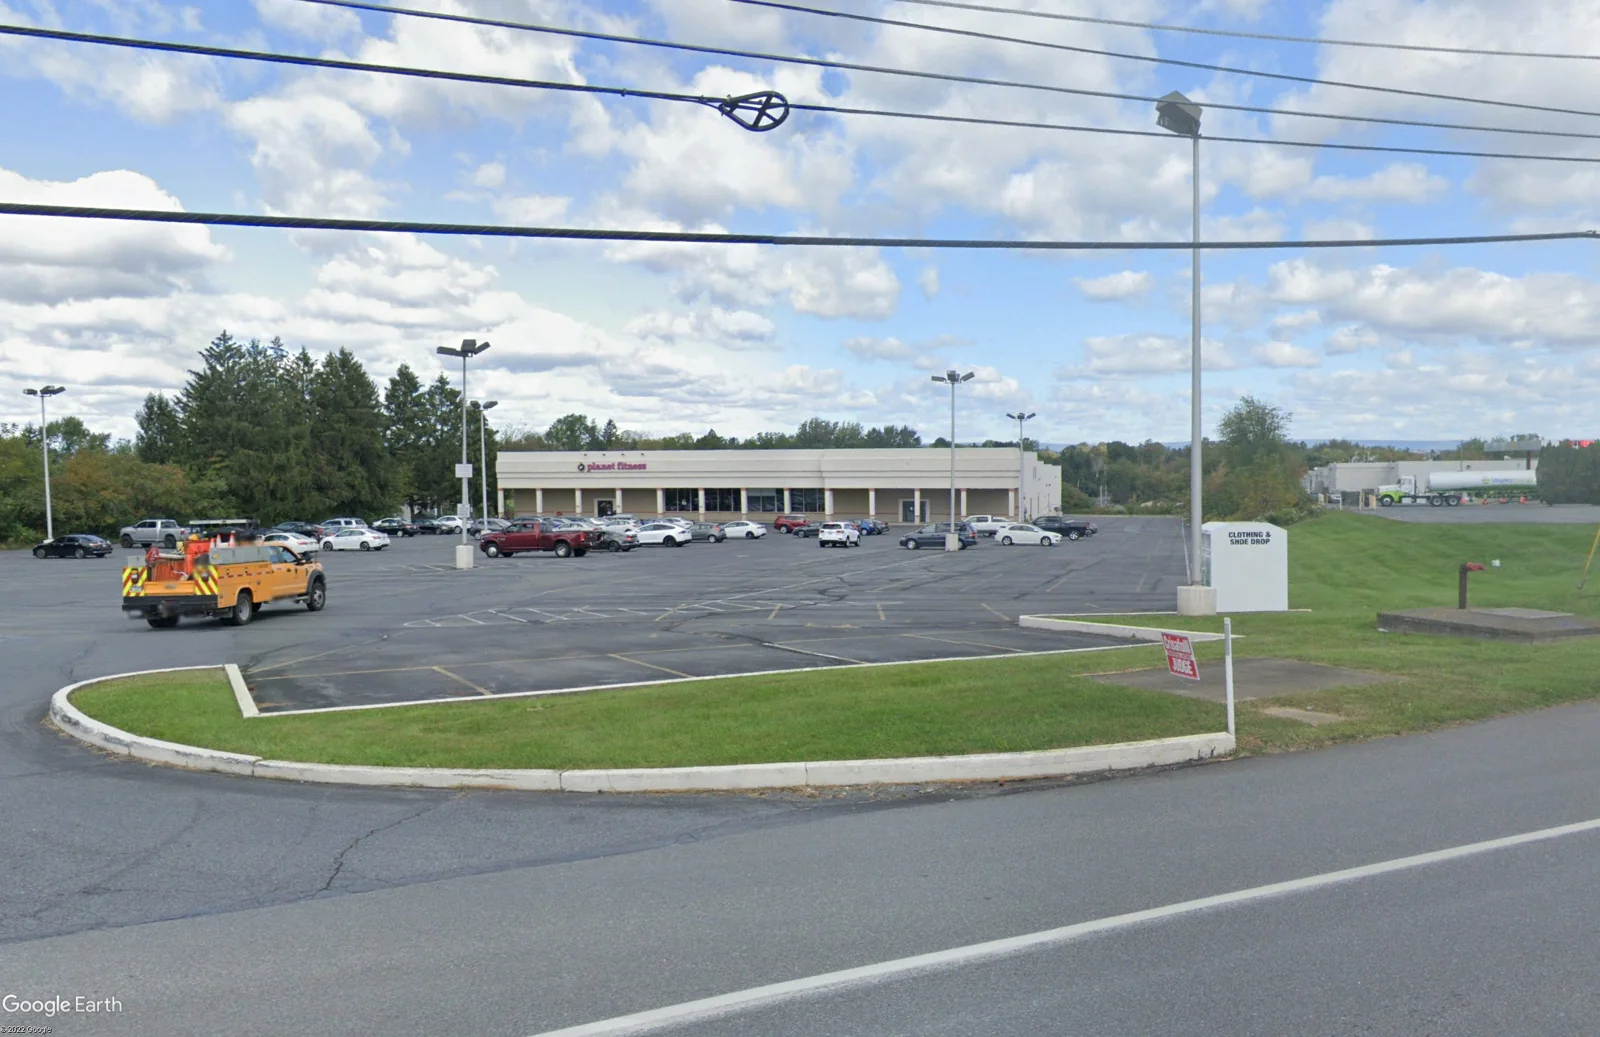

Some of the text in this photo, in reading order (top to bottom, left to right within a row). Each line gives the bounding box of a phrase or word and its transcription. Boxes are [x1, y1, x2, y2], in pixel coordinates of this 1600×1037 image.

[587, 461, 647, 472] planet fitness
[1172, 657, 1193, 674] JUDGE
